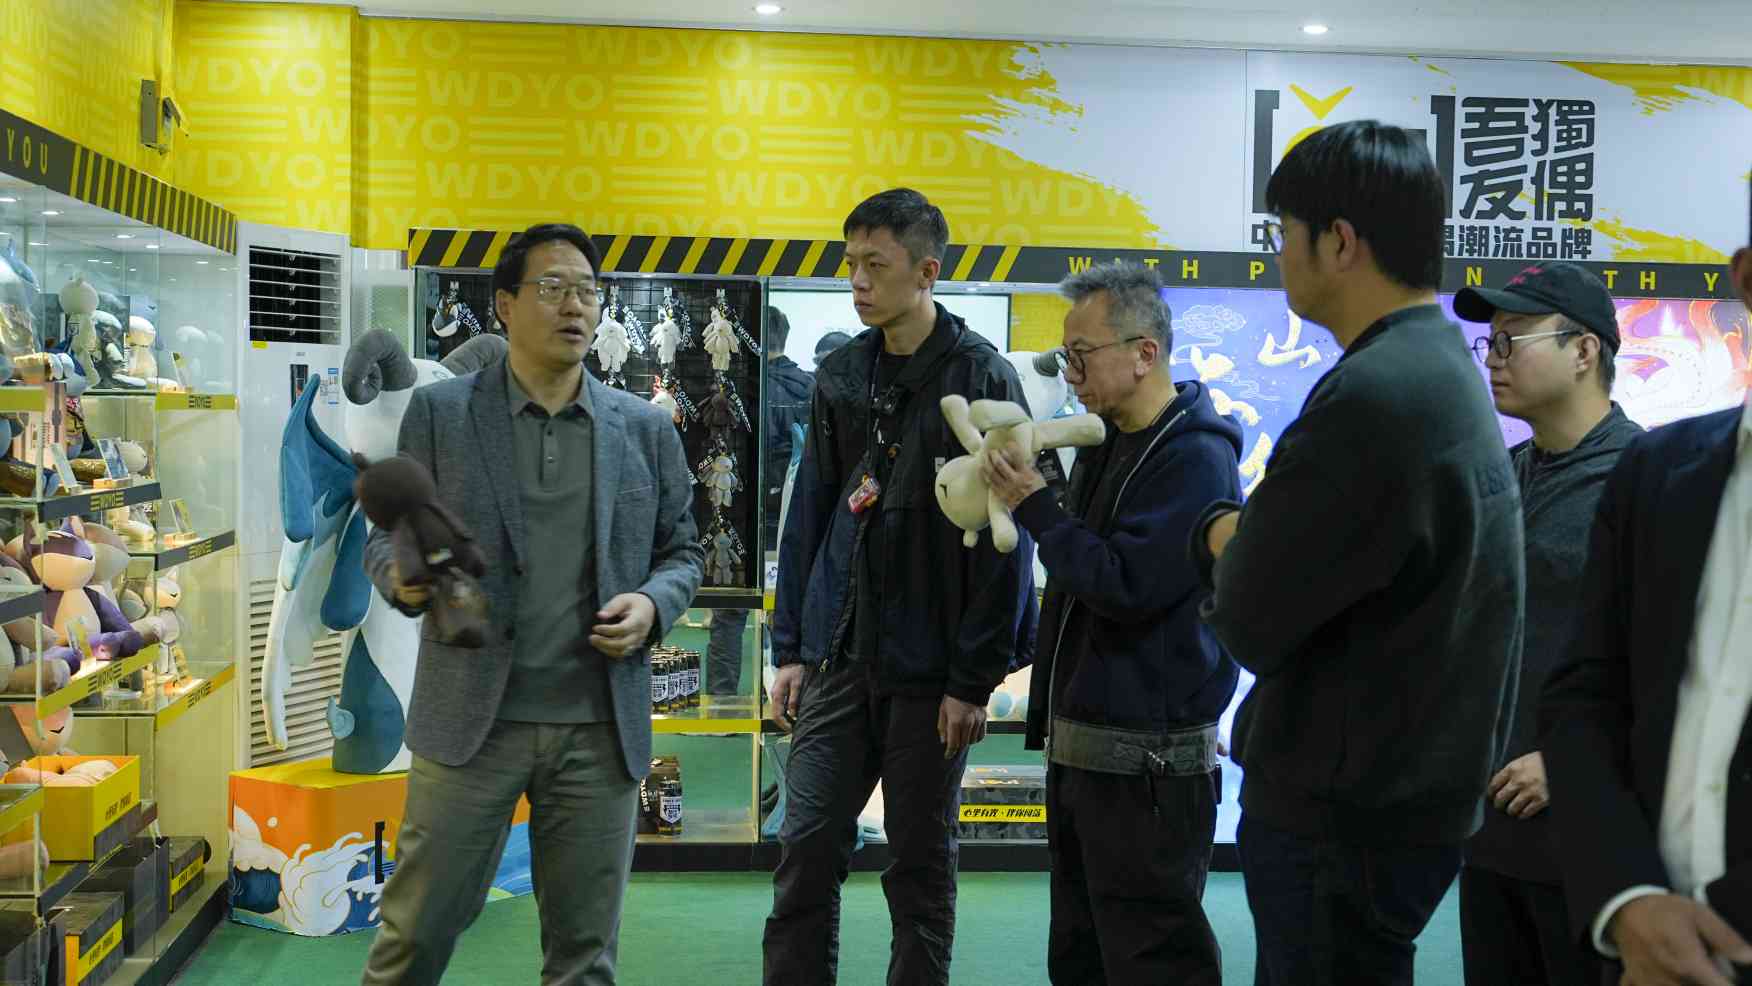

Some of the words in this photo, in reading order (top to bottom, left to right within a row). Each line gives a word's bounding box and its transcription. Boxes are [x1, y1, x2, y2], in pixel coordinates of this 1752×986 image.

[427, 70, 603, 109] WDYO
[717, 78, 892, 120] WDYO
[6, 127, 49, 176] YOU
[576, 120, 750, 160] WDYO
[426, 161, 603, 201] WDYO
[1001, 178, 1125, 217] WDY
